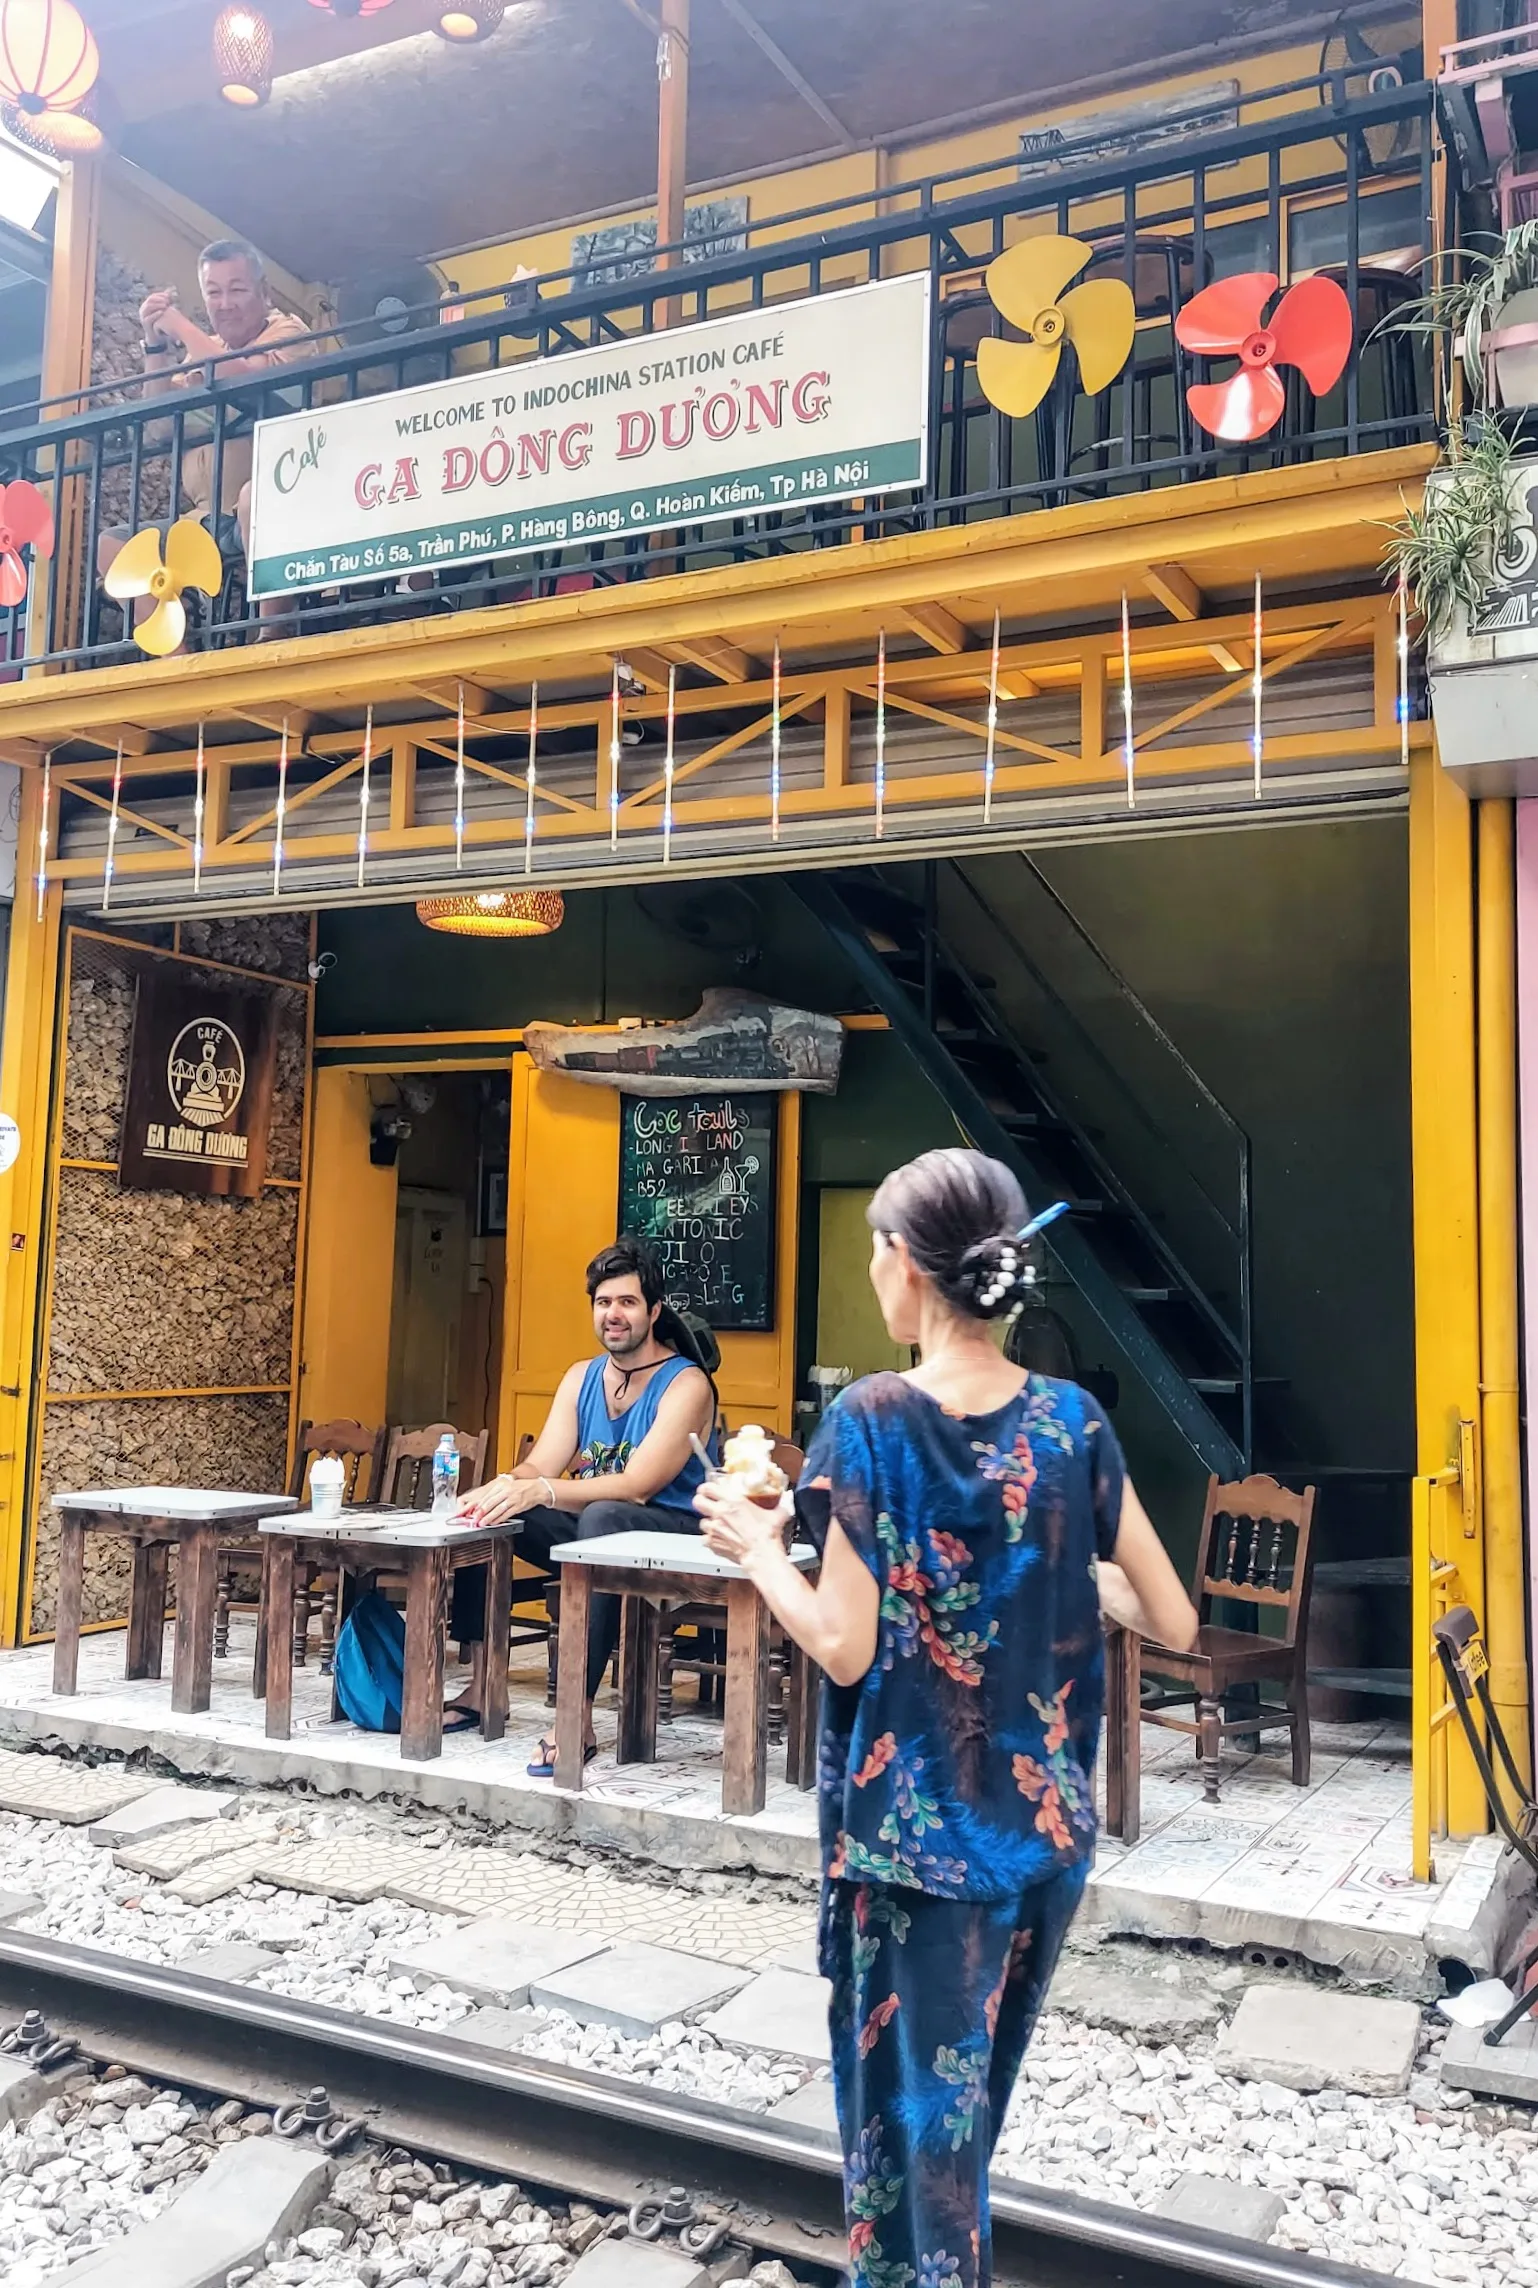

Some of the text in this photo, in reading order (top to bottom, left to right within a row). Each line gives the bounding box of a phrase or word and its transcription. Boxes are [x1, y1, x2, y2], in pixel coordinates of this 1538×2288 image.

[395, 331, 785, 437] WELCOME TO INDOCHINA STATION CAFÉ
[274, 425, 327, 494] Café
[354, 370, 832, 511] GA ĐÔNG DƯƠNG
[284, 460, 870, 581] Chắn Tàu Số 5a, Trần Phú, P. Hàng Bông, Q. Hoàn Kiếm, Tp Hà Nội
[197, 1027, 224, 1044] CAFÉ
[147, 1123, 164, 1149] GA
